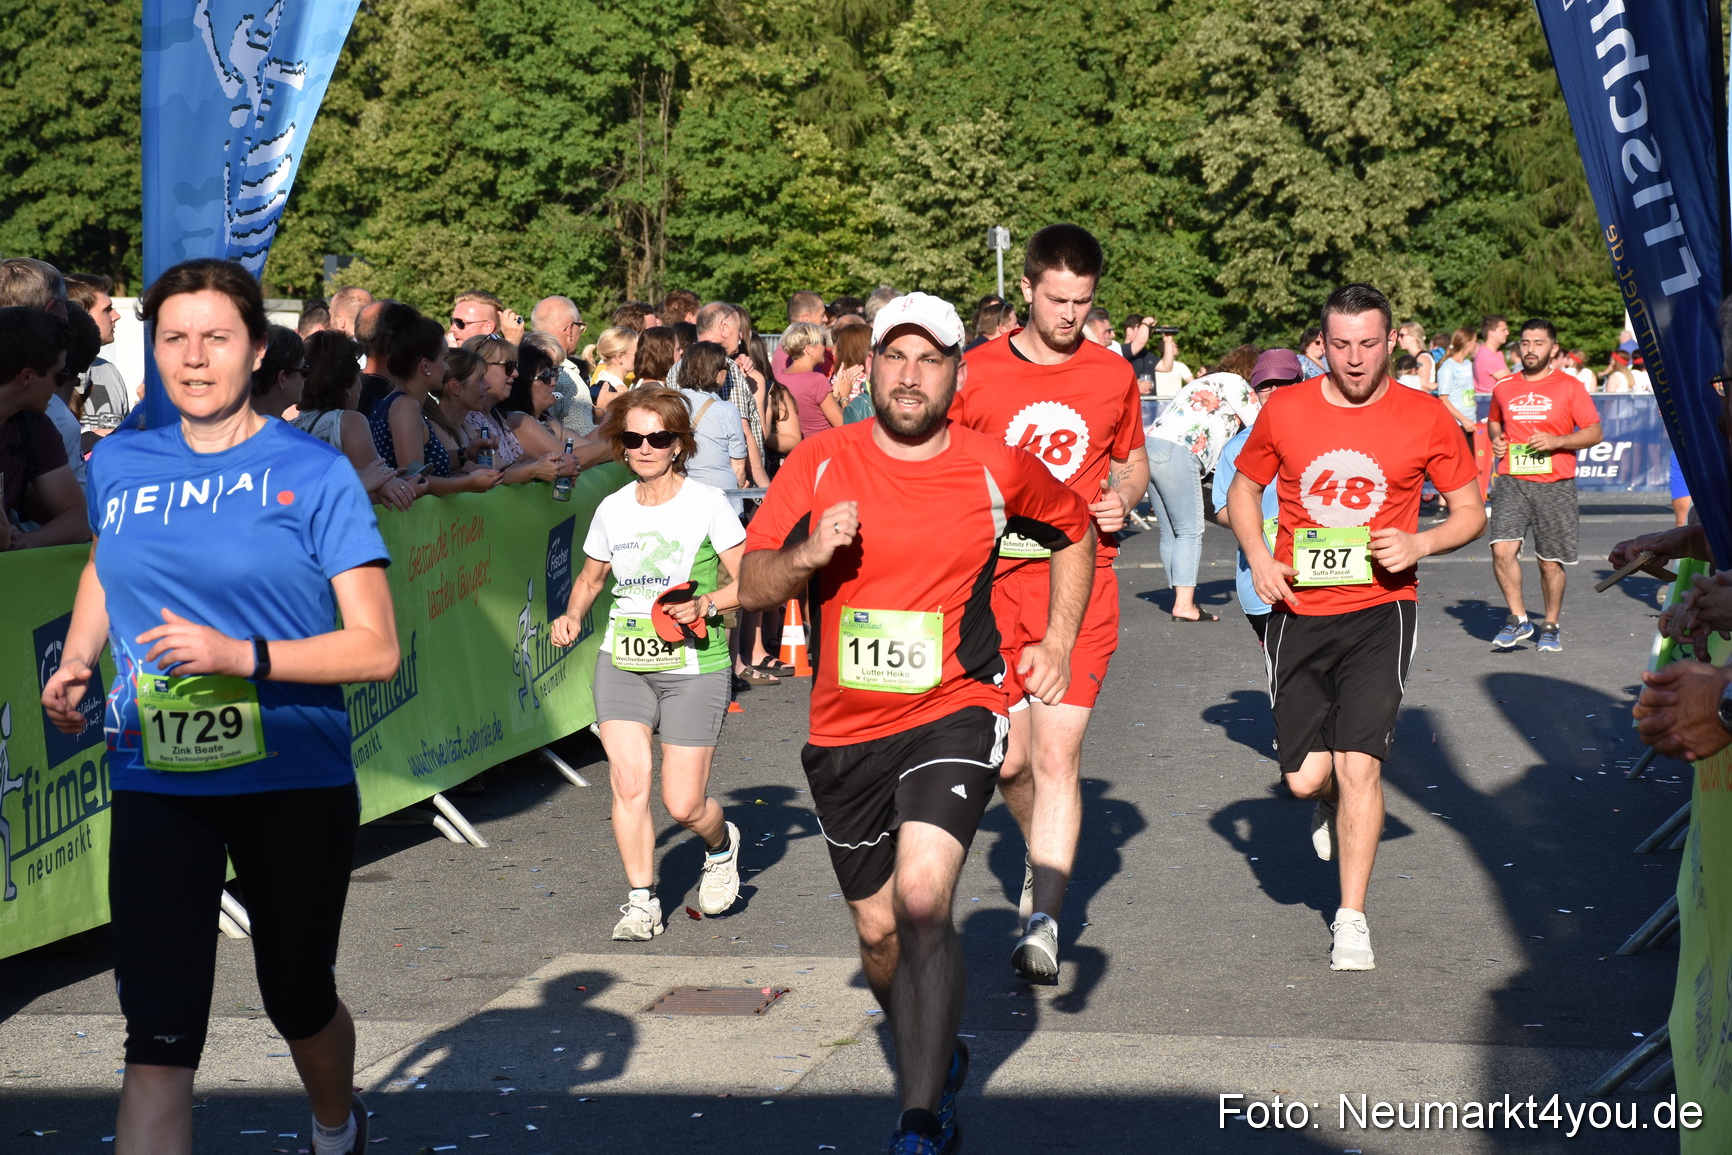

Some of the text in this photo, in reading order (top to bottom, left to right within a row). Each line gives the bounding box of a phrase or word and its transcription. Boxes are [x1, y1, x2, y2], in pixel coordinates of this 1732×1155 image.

[1017, 423, 1078, 467] 48
[1514, 454, 1545, 465] 1716
[1308, 469, 1376, 510] 48
[408, 516, 484, 582] Gesunde Firmen
[613, 542, 639, 551] BERATA
[1309, 548, 1352, 570] 787
[428, 572, 455, 621] laufen
[457, 544, 491, 605] länger!
[618, 575, 670, 587] Laufend
[618, 585, 664, 600] erfolgre
[621, 637, 675, 656] 1034
[849, 637, 926, 669] 1156
[540, 661, 567, 699] neumarkt
[862, 668, 910, 678] Lutter Heiko
[152, 706, 243, 744] 1729
[172, 744, 224, 755] Zink Beate
[175, 752, 219, 763] Technologies
[219, 749, 242, 758] GmbH
[27, 822, 93, 885] neumarkt
